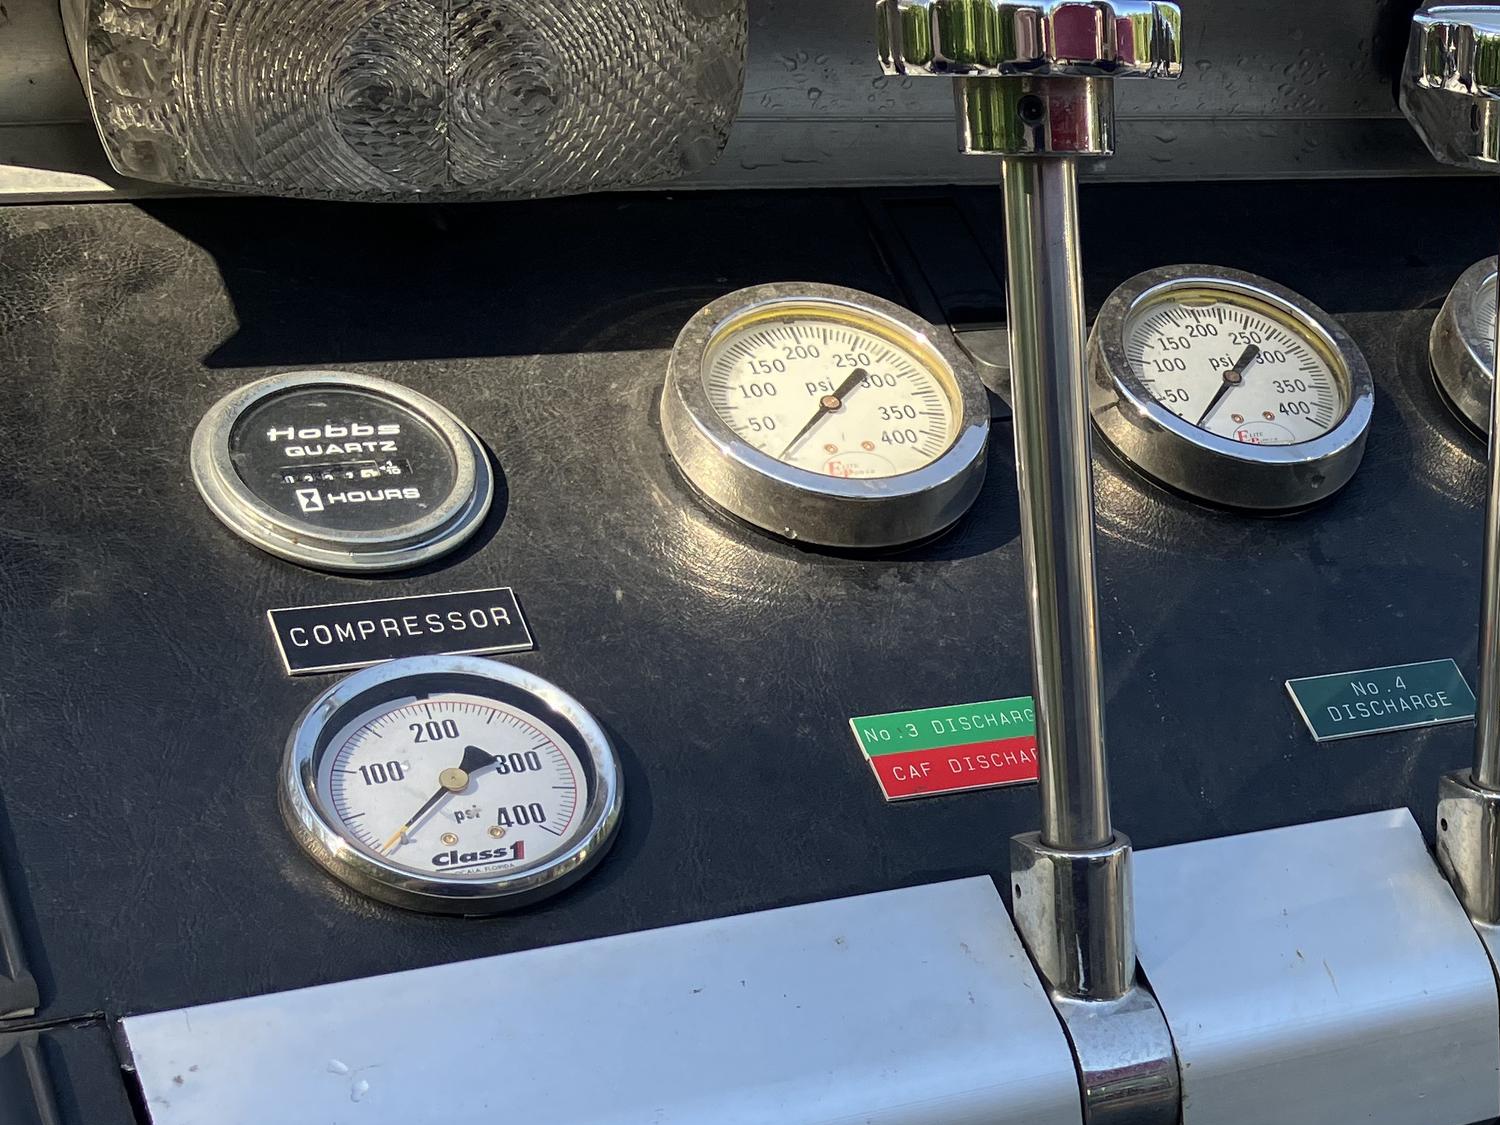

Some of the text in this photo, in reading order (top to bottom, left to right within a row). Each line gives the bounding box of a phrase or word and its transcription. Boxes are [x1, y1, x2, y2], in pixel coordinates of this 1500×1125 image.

[1185, 323, 1218, 338] 200
[1228, 331, 1262, 346] 250
[783, 344, 820, 361] 200
[1158, 336, 1191, 352] 150
[833, 352, 871, 369] 250
[1154, 357, 1187, 373] 100
[1208, 353, 1235, 371] psi
[1256, 350, 1286, 365] 300
[750, 359, 786, 375] 150
[805, 378, 835, 397] psi
[860, 373, 897, 388] 300
[1272, 379, 1306, 394] 350
[739, 382, 777, 398] 100
[878, 404, 916, 421] 350
[1279, 401, 1311, 416] 400
[267, 423, 400, 441] Hobbs
[748, 416, 776, 432] 50
[881, 429, 917, 445] 400
[285, 440, 398, 457] QUARTZ
[327, 488, 420, 504] HOURS
[289, 606, 512, 647] COMPRESSOR
[1327, 691, 1453, 722] DISCHARGE
[931, 708, 1035, 735] DISCHARG
[409, 719, 460, 744] 200
[495, 751, 542, 775] 300
[892, 762, 932, 781] CAF
[359, 760, 405, 786] 100
[498, 803, 547, 829] 400
[431, 840, 525, 867] Class1
